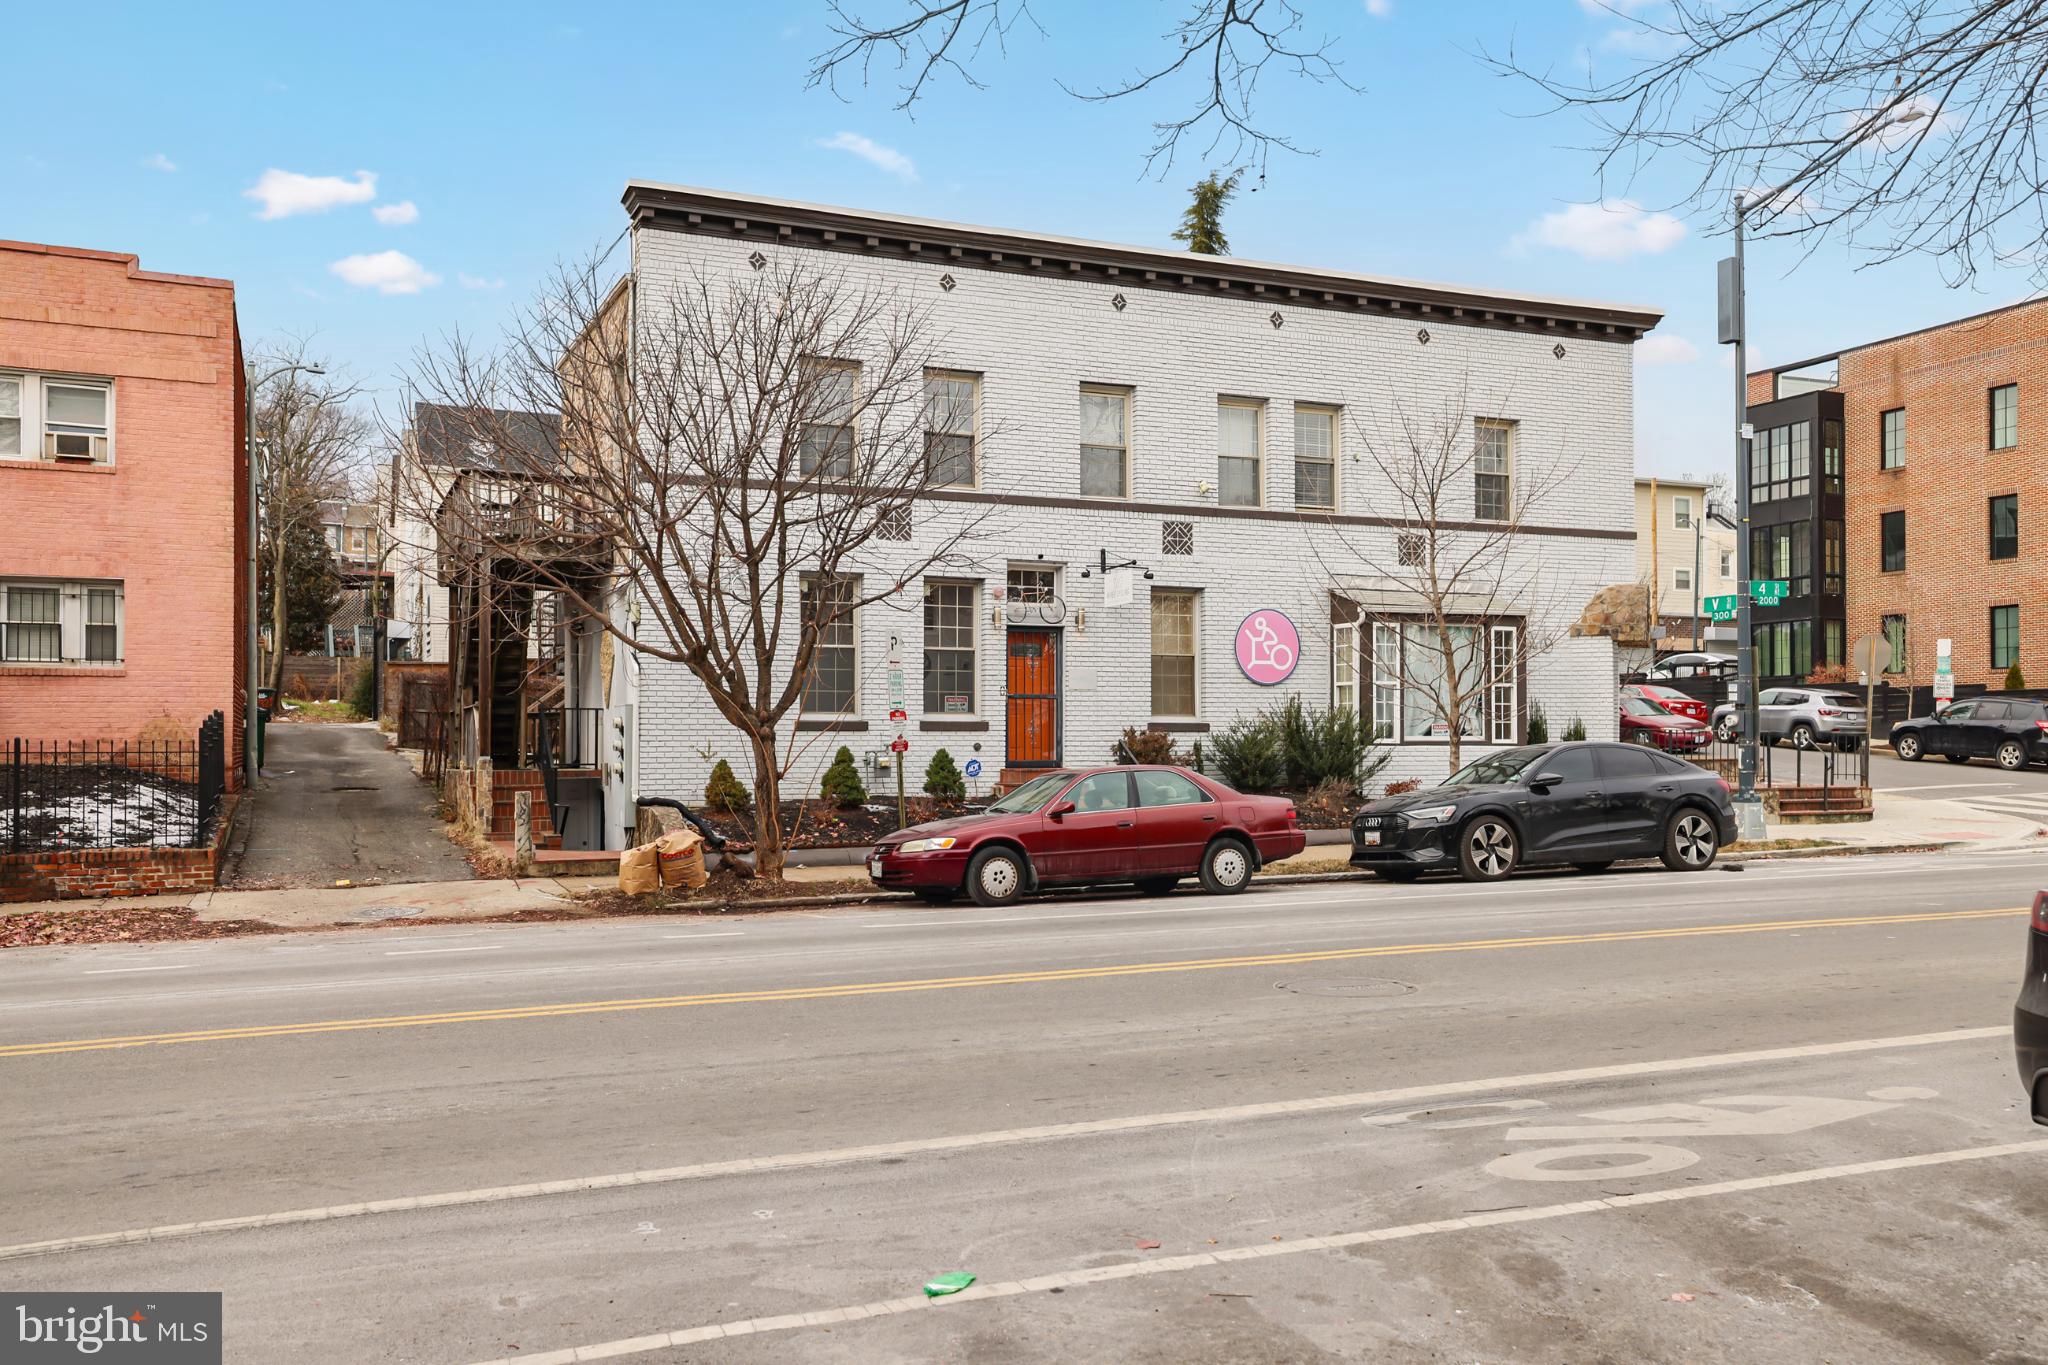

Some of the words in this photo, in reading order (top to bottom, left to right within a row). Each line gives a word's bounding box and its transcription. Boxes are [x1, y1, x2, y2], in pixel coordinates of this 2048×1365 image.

[1759, 583, 1766, 595] 4
[1712, 598, 1719, 611] V
[1759, 597, 1779, 605] 2000
[1714, 611, 1730, 620] 300
[660, 848, 694, 859] COSTCO
